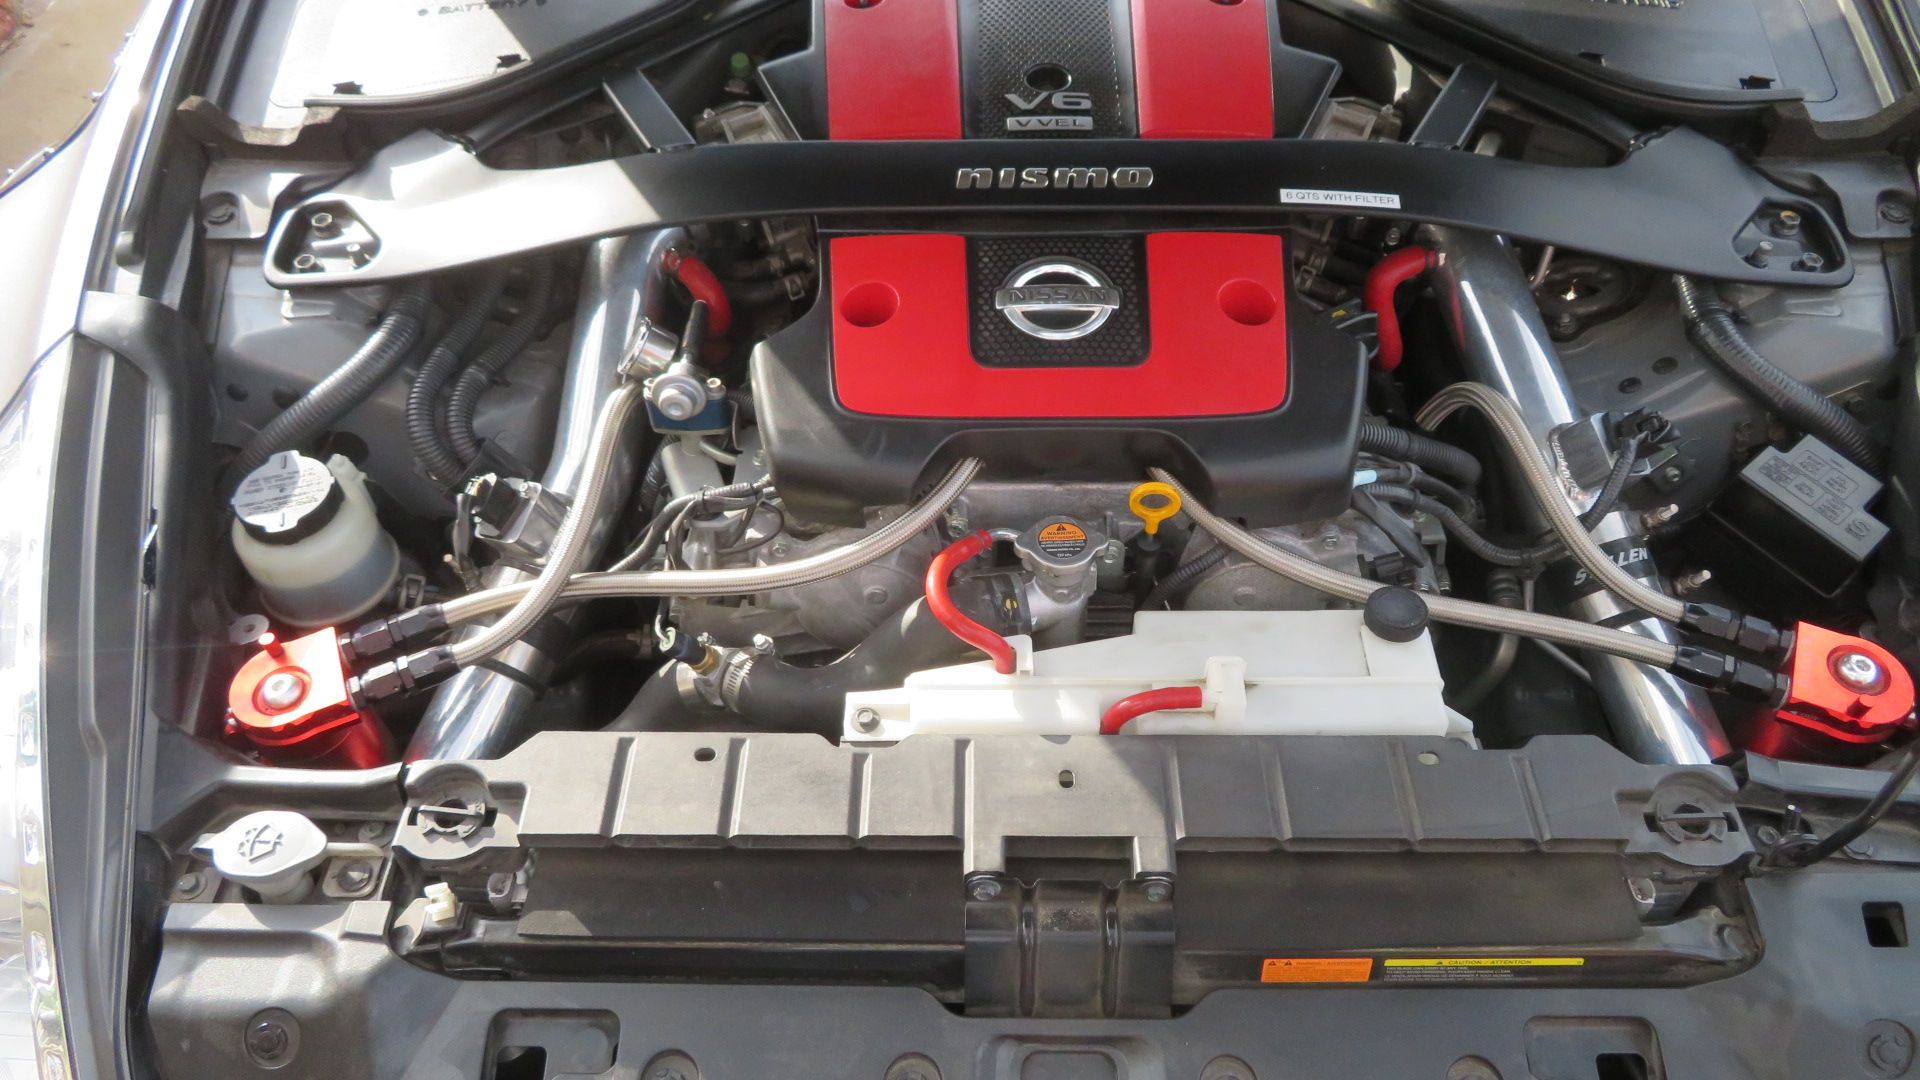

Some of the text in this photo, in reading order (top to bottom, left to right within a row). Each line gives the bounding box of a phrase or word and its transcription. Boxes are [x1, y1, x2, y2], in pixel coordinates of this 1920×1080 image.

[1004, 91, 1092, 110] V6
[1015, 118, 1086, 127] VVEL
[1286, 191, 1395, 204] 6 QTS WITH FILTER
[1009, 287, 1106, 302] NISSAN
